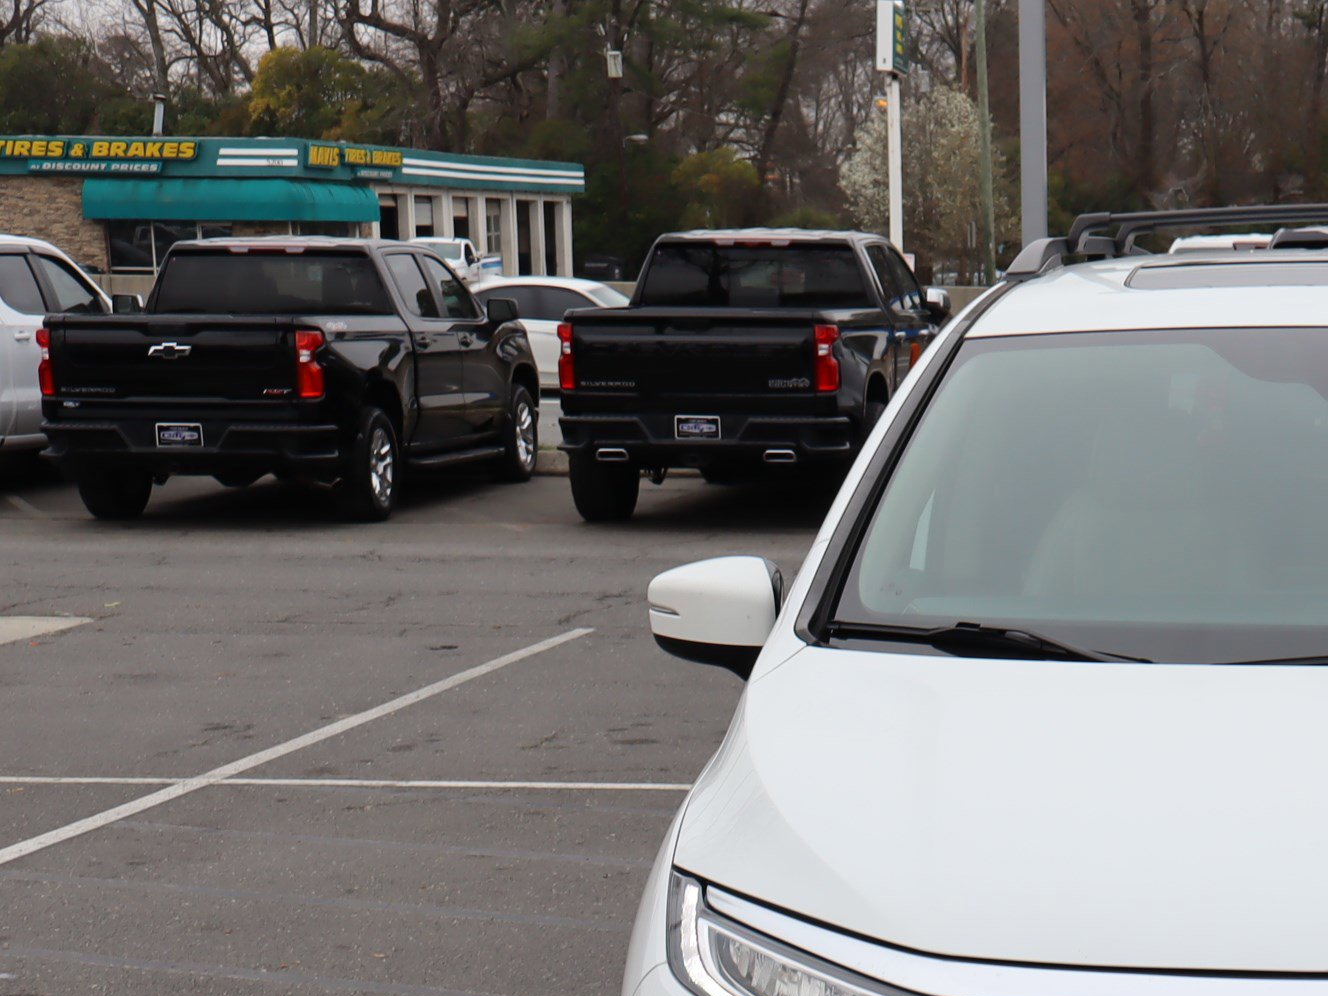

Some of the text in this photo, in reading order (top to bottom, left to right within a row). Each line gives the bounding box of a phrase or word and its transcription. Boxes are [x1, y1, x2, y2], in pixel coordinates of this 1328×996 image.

[69, 143, 84, 157] &
[91, 141, 196, 158] BRAKES
[41, 162, 106, 171] DISCOUNT
[110, 163, 158, 172] PRICES
